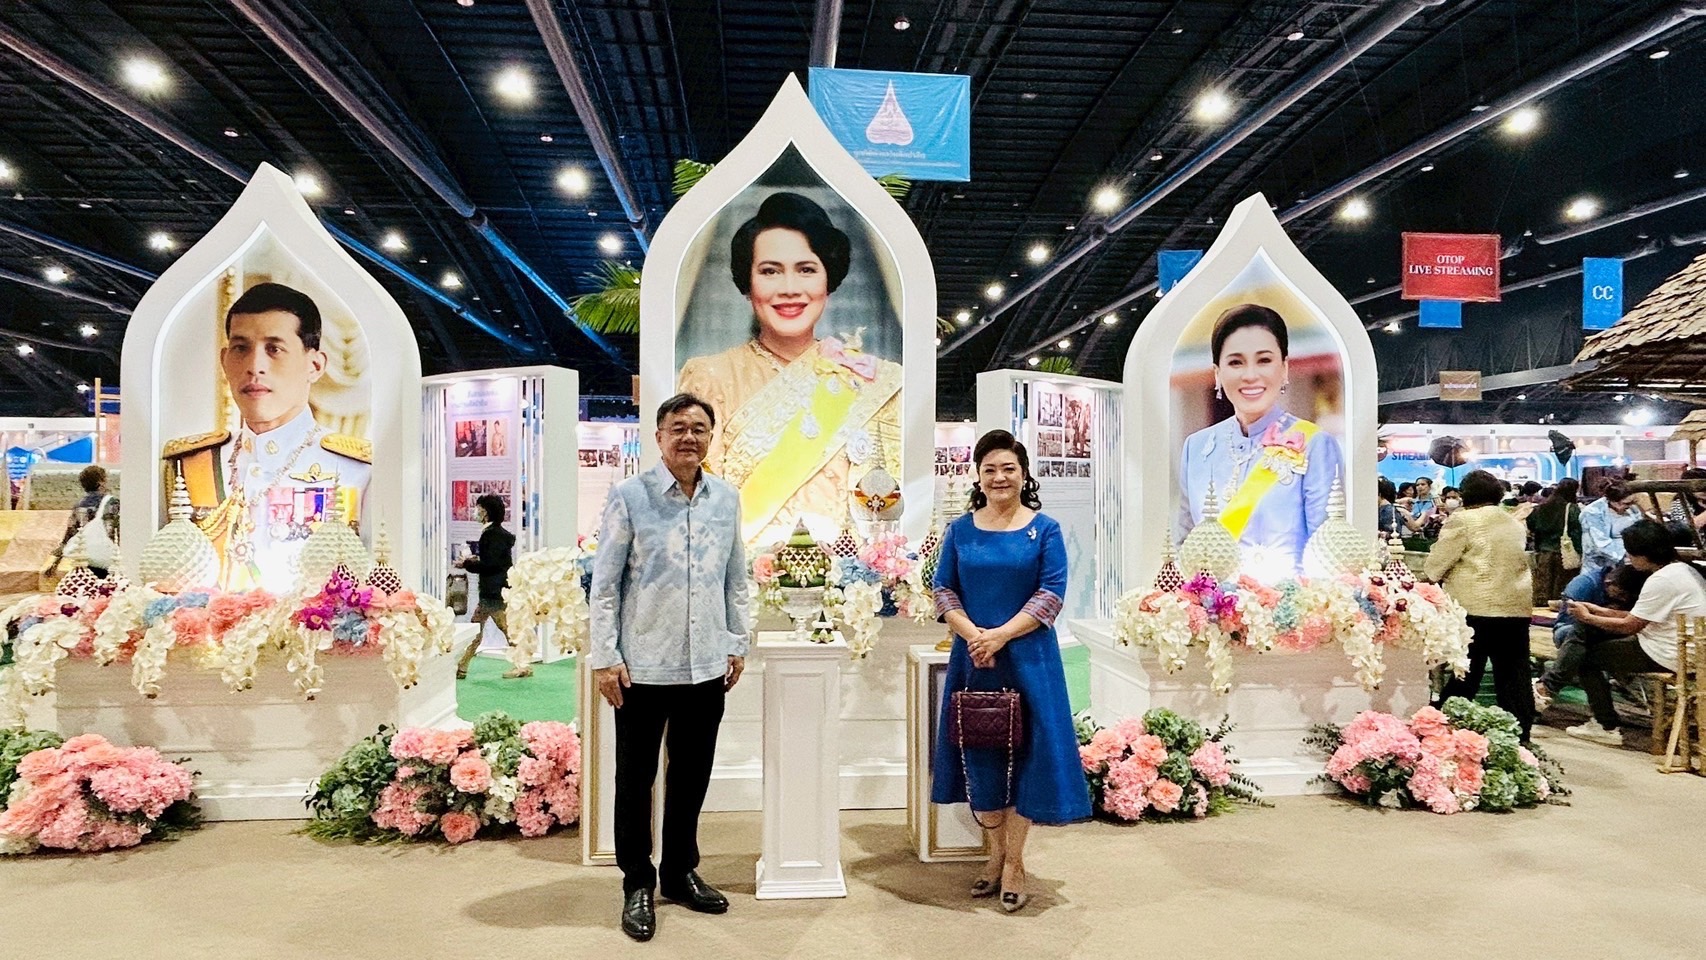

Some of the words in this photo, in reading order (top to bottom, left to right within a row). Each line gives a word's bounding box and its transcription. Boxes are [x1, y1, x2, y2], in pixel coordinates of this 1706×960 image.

[1436, 255, 1465, 264] OTOP
[1409, 265, 1432, 274] LIVE
[1433, 265, 1494, 276] STREAMING
[1592, 285, 1614, 300] CC
